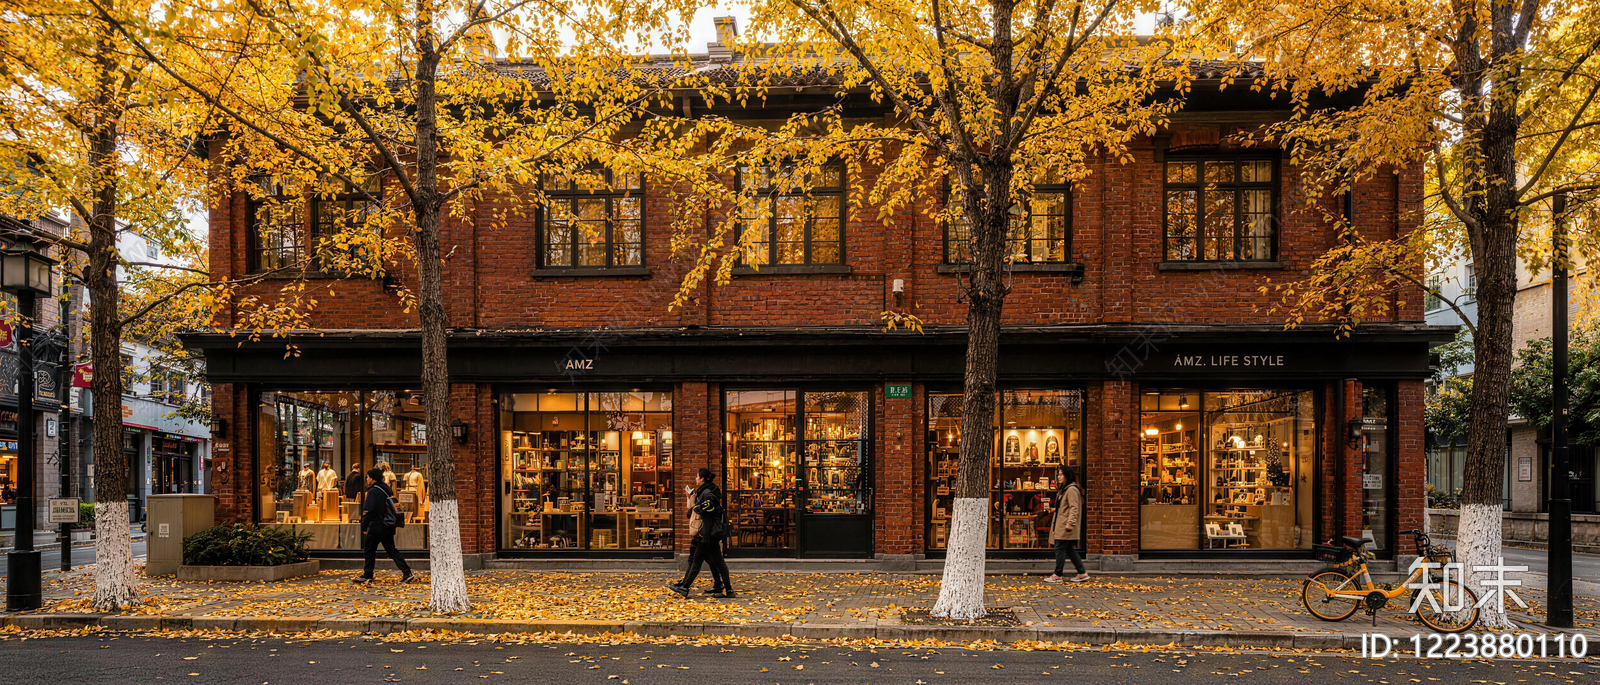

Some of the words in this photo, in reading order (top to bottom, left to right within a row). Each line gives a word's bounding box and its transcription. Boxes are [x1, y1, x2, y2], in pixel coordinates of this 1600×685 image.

[565, 359, 594, 370] AMZ
[1211, 355, 1239, 368] LIFE
[1243, 355, 1284, 368] STYLE
